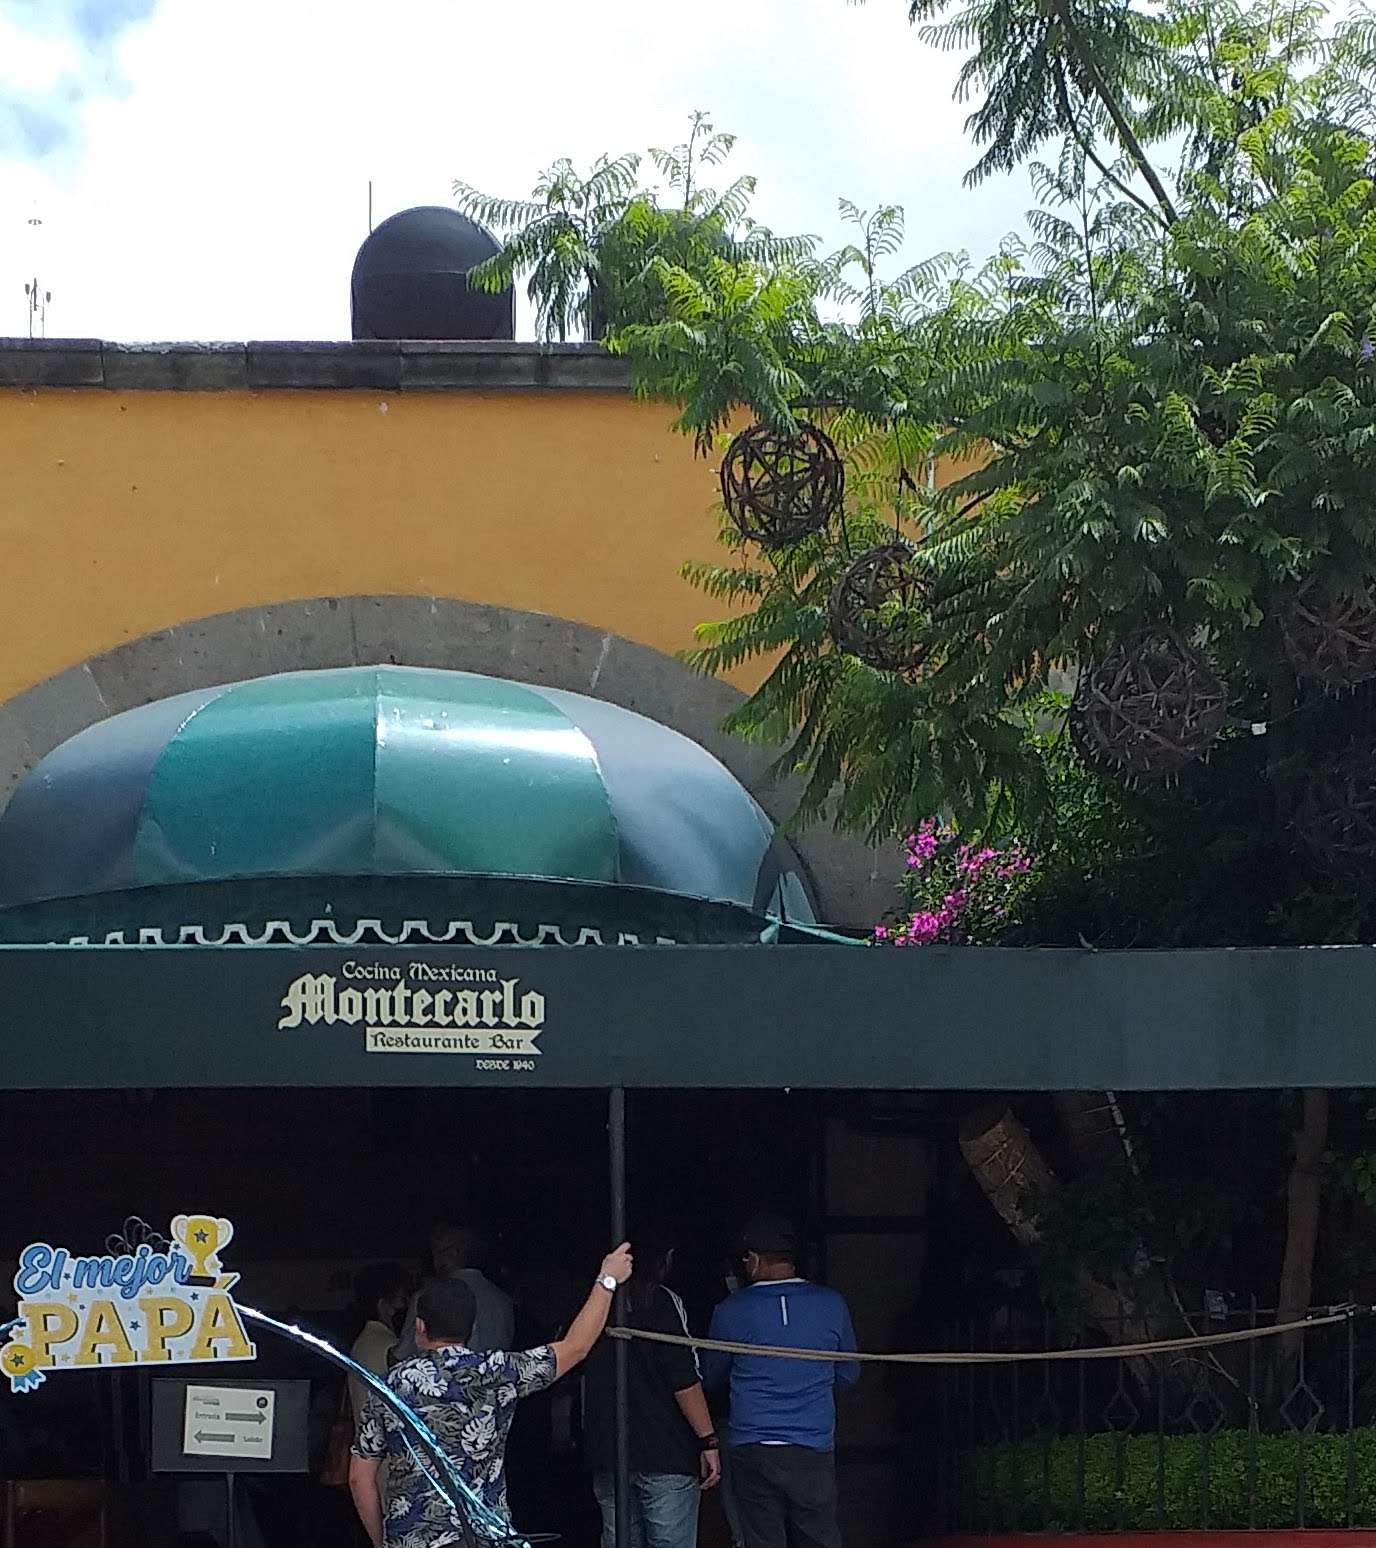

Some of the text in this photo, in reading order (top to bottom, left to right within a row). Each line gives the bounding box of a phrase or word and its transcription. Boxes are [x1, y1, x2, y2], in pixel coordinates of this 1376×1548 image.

[342, 960, 497, 983] Cocina Mexicana
[278, 973, 545, 1030] Montecarlo
[371, 1031, 524, 1050] Restaurante Bar
[16, 1244, 192, 1300] El mejor
